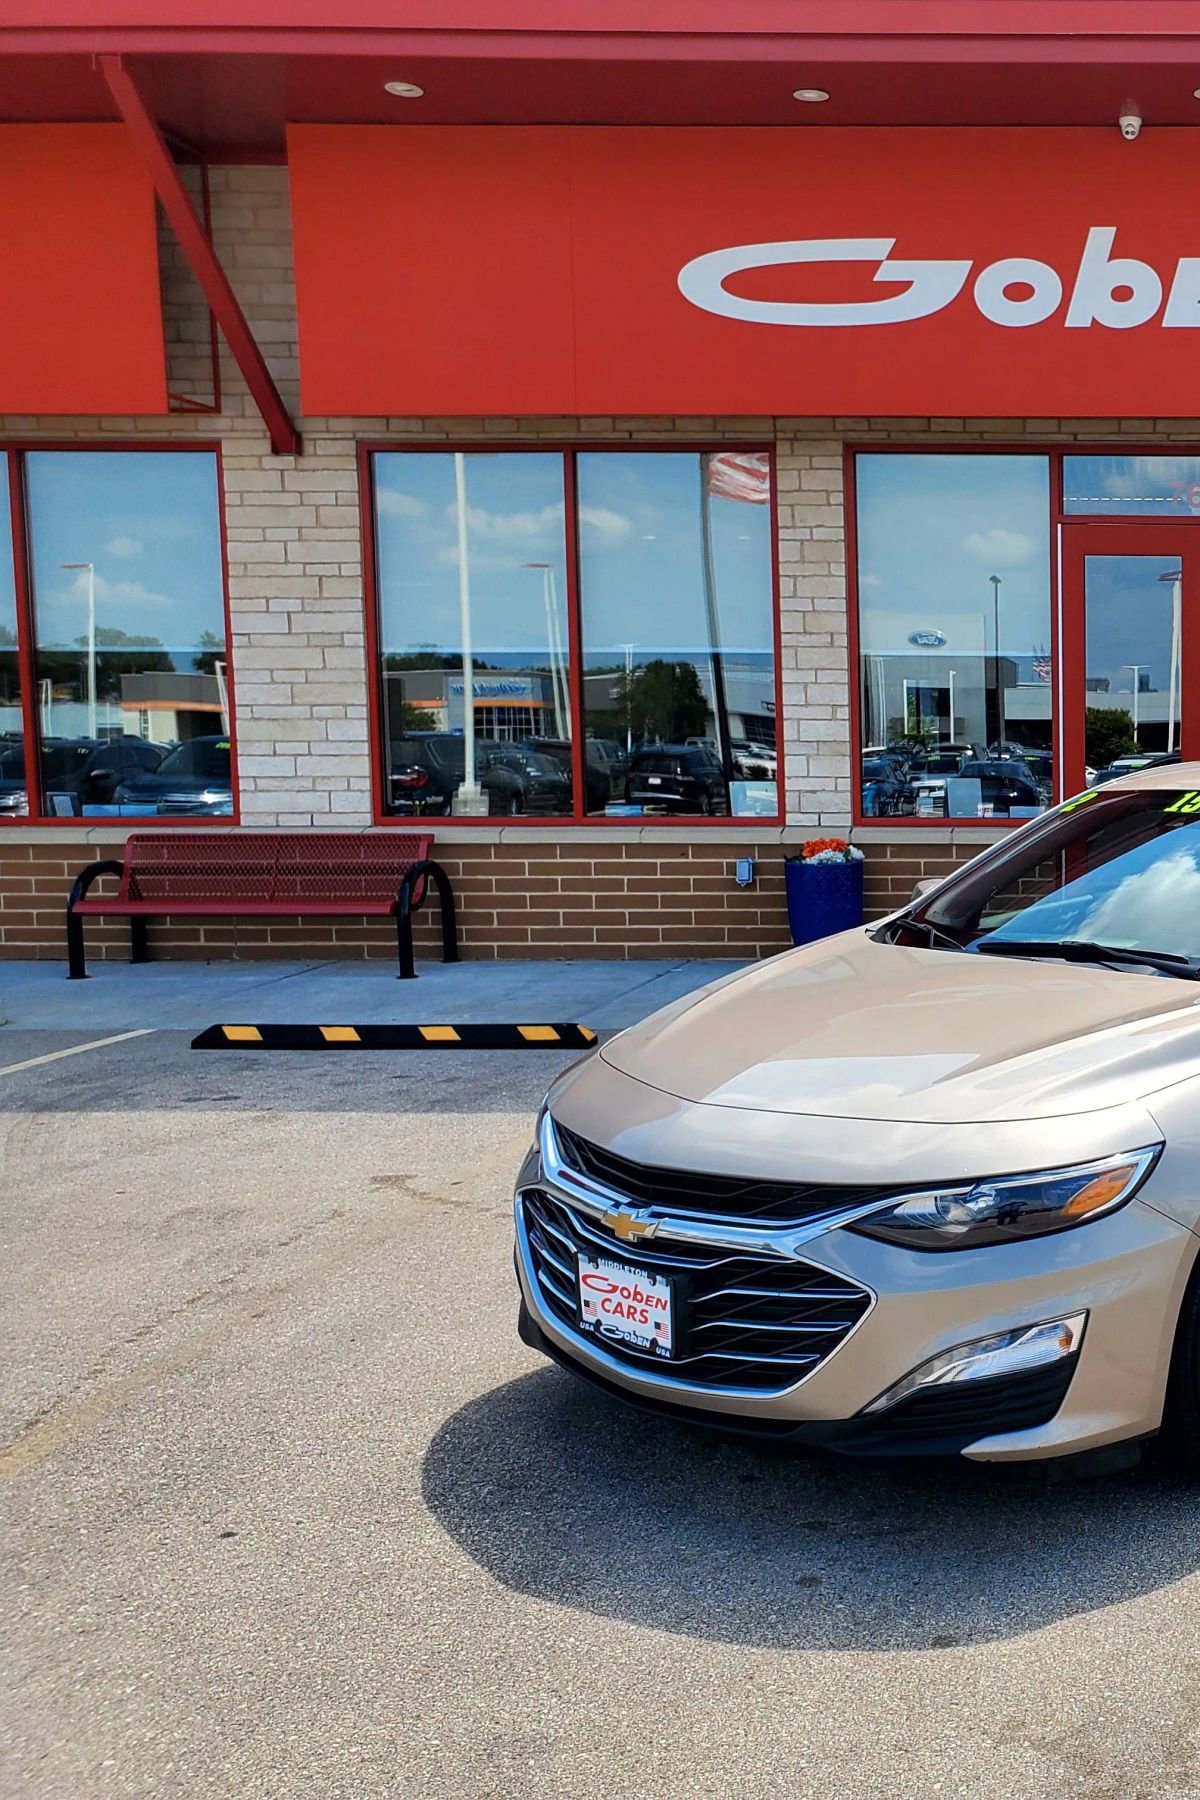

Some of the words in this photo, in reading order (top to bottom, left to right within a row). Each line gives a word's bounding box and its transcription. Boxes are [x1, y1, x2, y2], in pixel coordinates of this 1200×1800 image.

[598, 1258, 648, 1278] MIDDLETON
[601, 1297, 650, 1325] CARS
[580, 1321, 595, 1332] USA
[656, 1346, 671, 1358] USA
